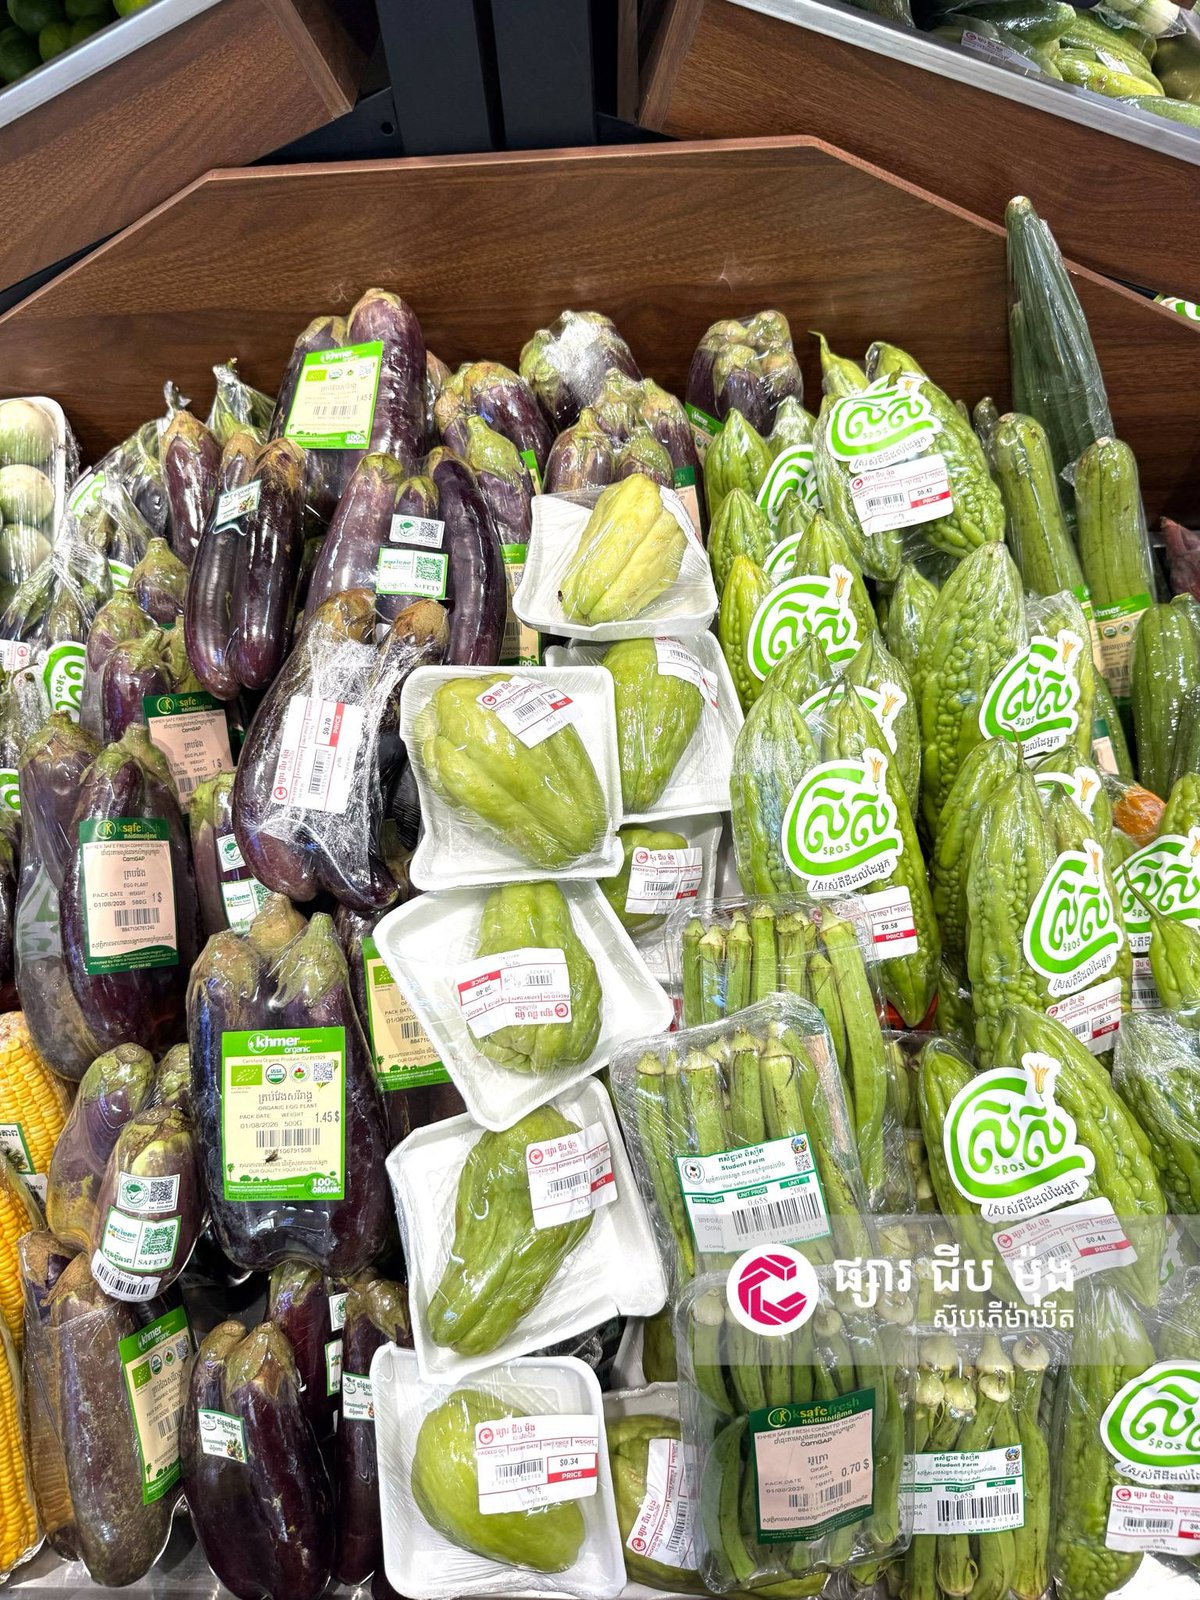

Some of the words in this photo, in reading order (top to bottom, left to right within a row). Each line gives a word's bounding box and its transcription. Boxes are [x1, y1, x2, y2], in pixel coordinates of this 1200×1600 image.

[55, 674, 66, 699] SROS
[1015, 715, 1035, 727] SROS
[823, 842, 851, 856] SROS
[812, 858, 890, 891] ស្រស់ពីដីដល់ដៃអ្នក
[157, 891, 163, 903] $
[881, 922, 899, 931] $0.58
[885, 932, 904, 940] PRICE
[1063, 937, 1081, 953] SROS
[255, 1035, 301, 1048] khmer
[284, 1046, 311, 1055] organic
[315, 1111, 333, 1123] 1.45
[334, 1110, 340, 1123] $
[240, 1121, 279, 1129] 01/08/2026
[721, 1161, 747, 1171] Student
[748, 1157, 766, 1165] Farm
[994, 1161, 1026, 1176] SROS
[312, 1177, 337, 1186] 100%
[787, 1179, 800, 1187] UNIT
[988, 1180, 1079, 1217] ស្រស់ពីដីដល់ដៃអ្នក
[1085, 1235, 1106, 1243] $0.44
[1094, 1244, 1116, 1253] PRICE
[137, 1257, 169, 1265] SAFETY
[800, 1437, 832, 1447] CamGAP
[1149, 1438, 1182, 1450] SROS
[559, 1457, 579, 1467] $0.34
[810, 1465, 829, 1473] OKRA
[841, 1462, 861, 1477] 0.70
[863, 1459, 870, 1470] $
[561, 1471, 582, 1479] PRICE
